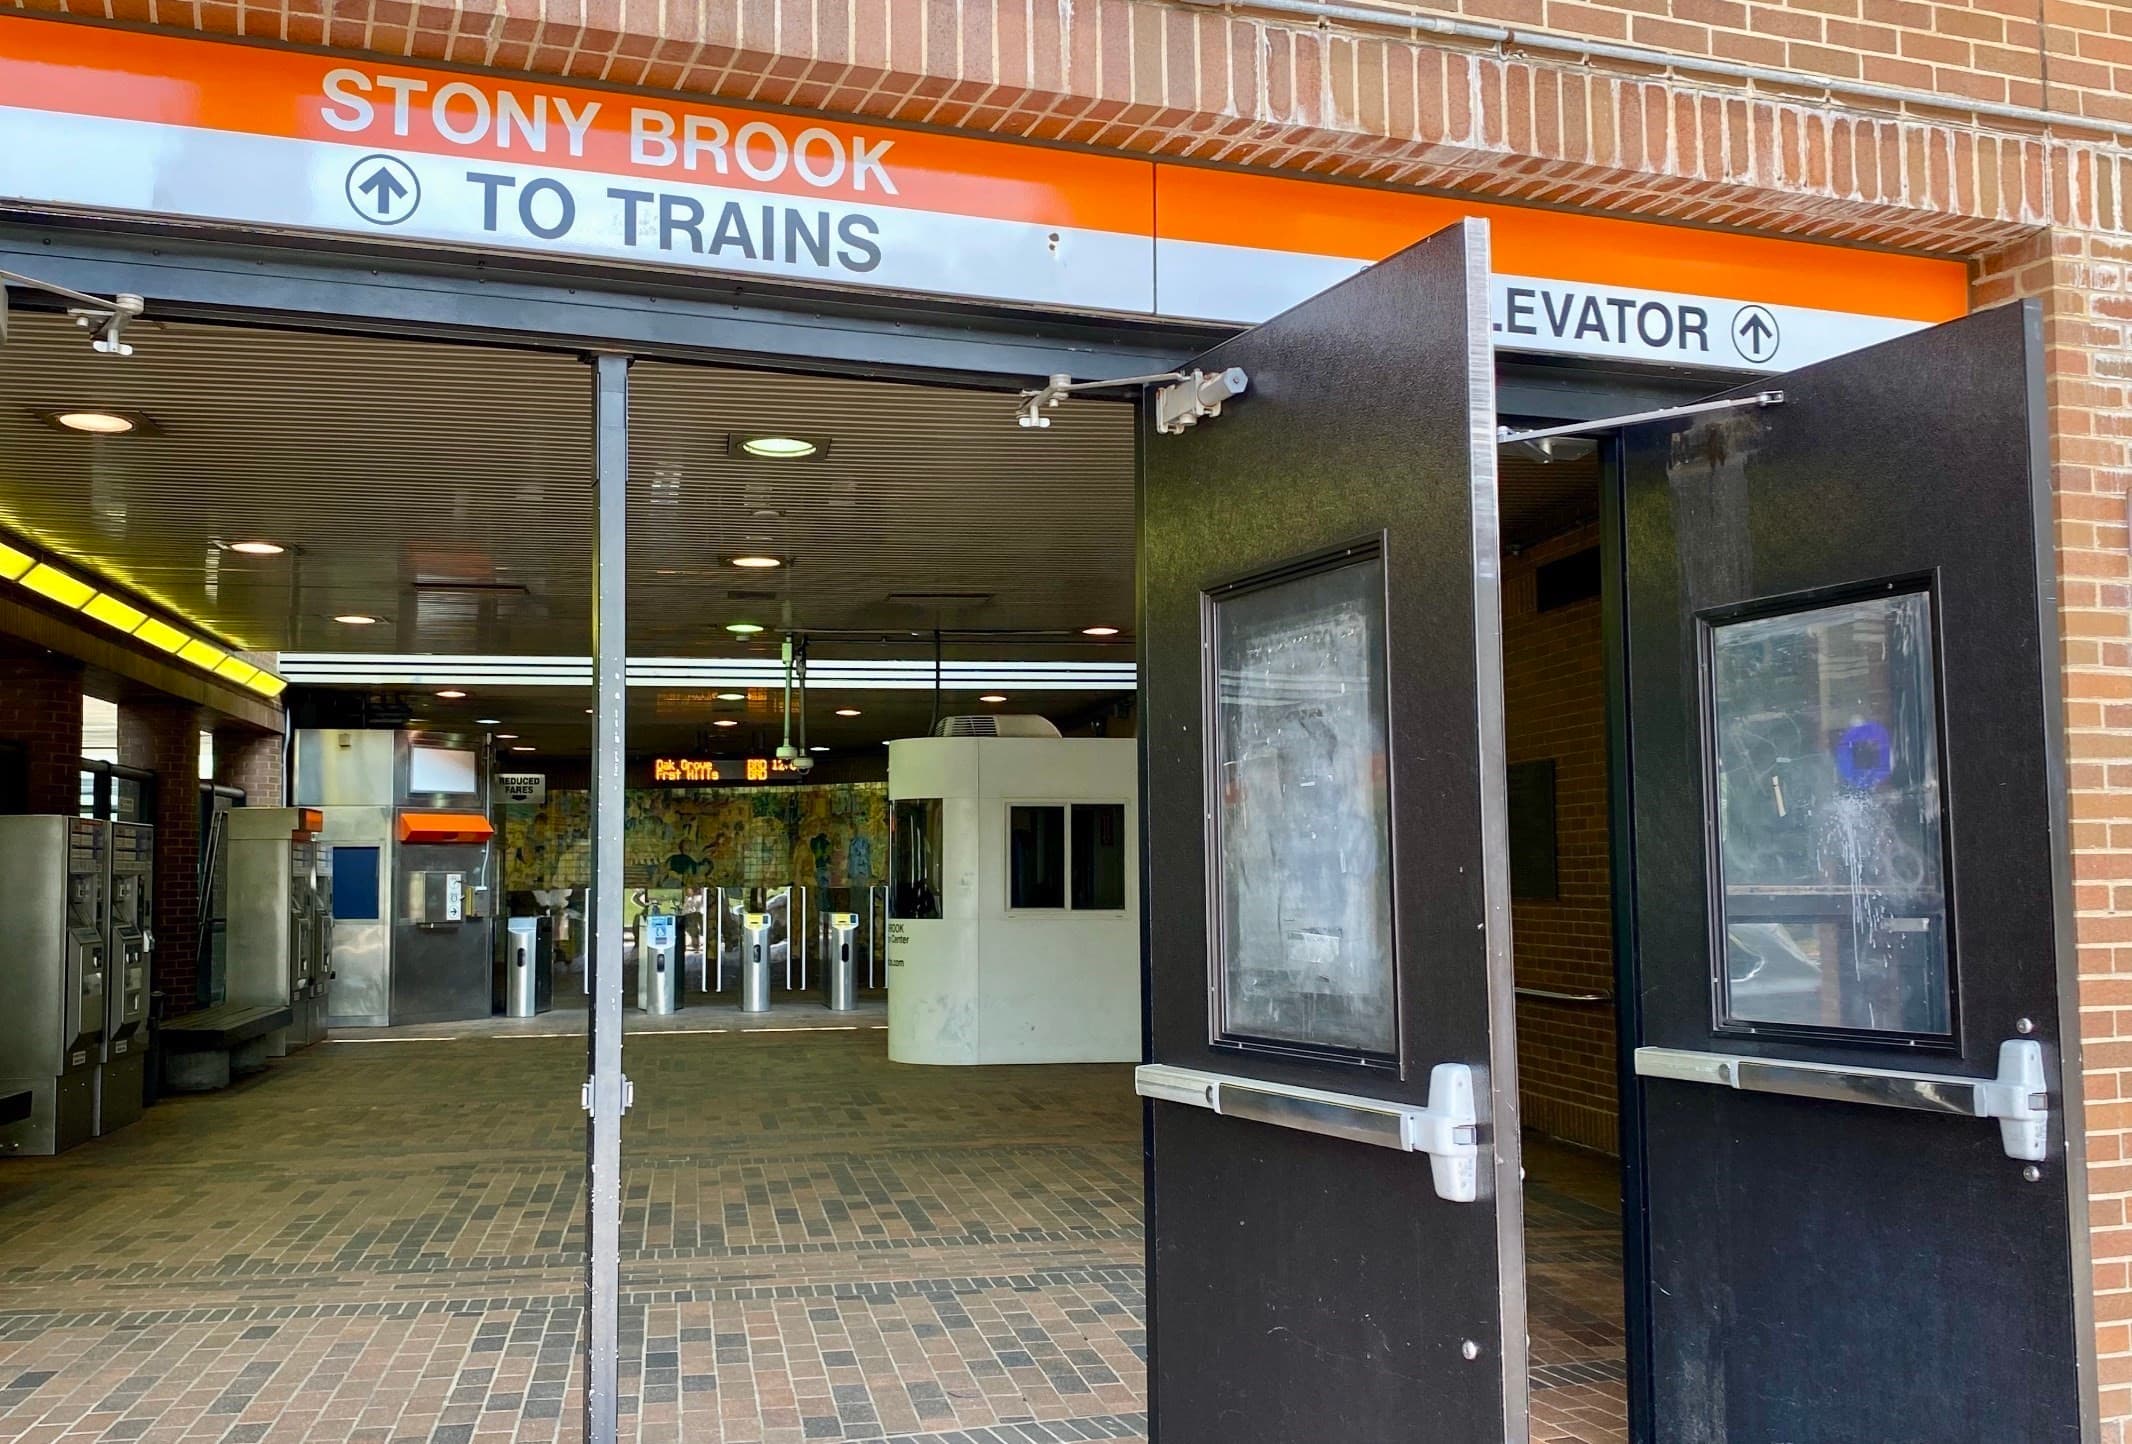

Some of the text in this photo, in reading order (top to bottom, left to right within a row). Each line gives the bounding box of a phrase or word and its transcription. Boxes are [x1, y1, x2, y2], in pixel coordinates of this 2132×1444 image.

[320, 68, 900, 195] STONY BROOK
[466, 171, 882, 273] TO TRAINS
[1493, 287, 1710, 352] EVATOR
[655, 759, 676, 770] Oak
[680, 759, 713, 770] Grove
[655, 769, 682, 780] Frst
[686, 769, 720, 780] Hills
[498, 777, 540, 785] REDUCED
[504, 786, 534, 794] FARES
